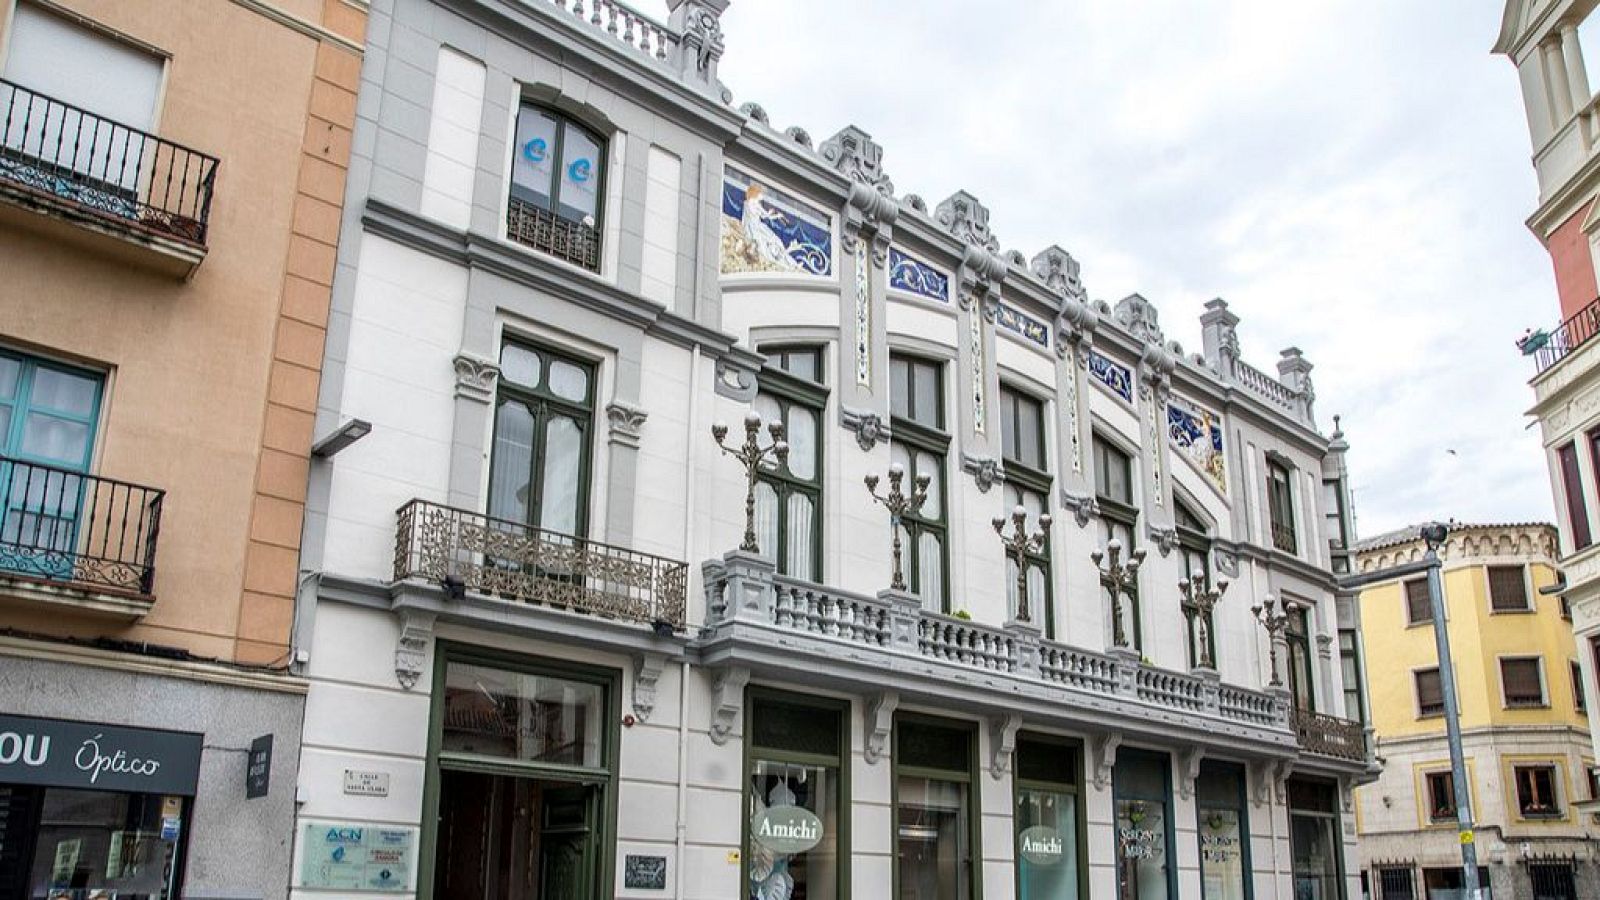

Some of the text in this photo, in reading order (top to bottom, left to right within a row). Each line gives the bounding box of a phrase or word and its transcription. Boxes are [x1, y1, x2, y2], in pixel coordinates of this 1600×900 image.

[74, 733, 161, 784] Óptico
[327, 828, 362, 842] ACN
[759, 816, 817, 840] Amichi
[1022, 836, 1062, 854] Amichi
